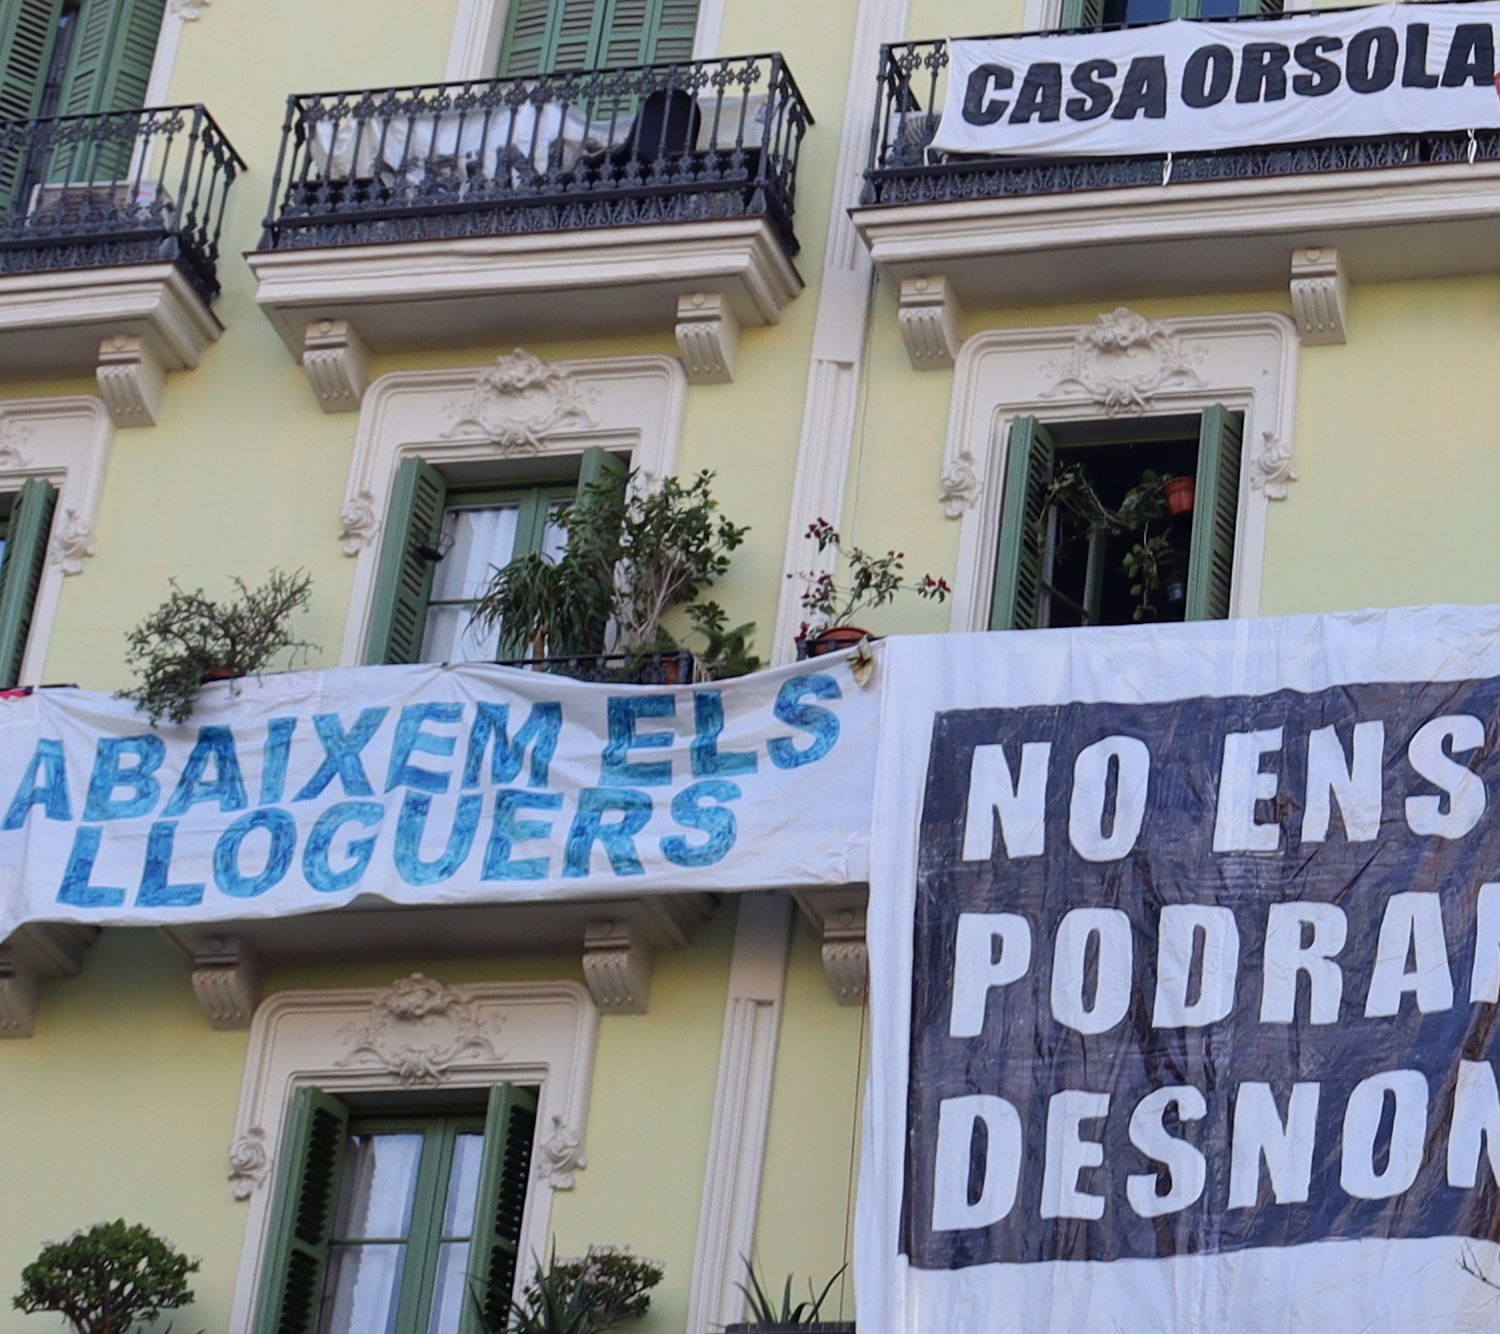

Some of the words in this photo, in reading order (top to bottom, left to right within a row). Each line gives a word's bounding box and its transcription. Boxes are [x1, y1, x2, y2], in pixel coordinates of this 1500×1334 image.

[962, 54, 1168, 127] CASA
[1179, 22, 1495, 109] ORSOLA
[0, 700, 564, 831] ABAIXEM
[597, 673, 844, 787] ELS
[961, 734, 1151, 864] NO
[1212, 714, 1488, 855] ENS
[55, 780, 742, 908] LLOGUERS
